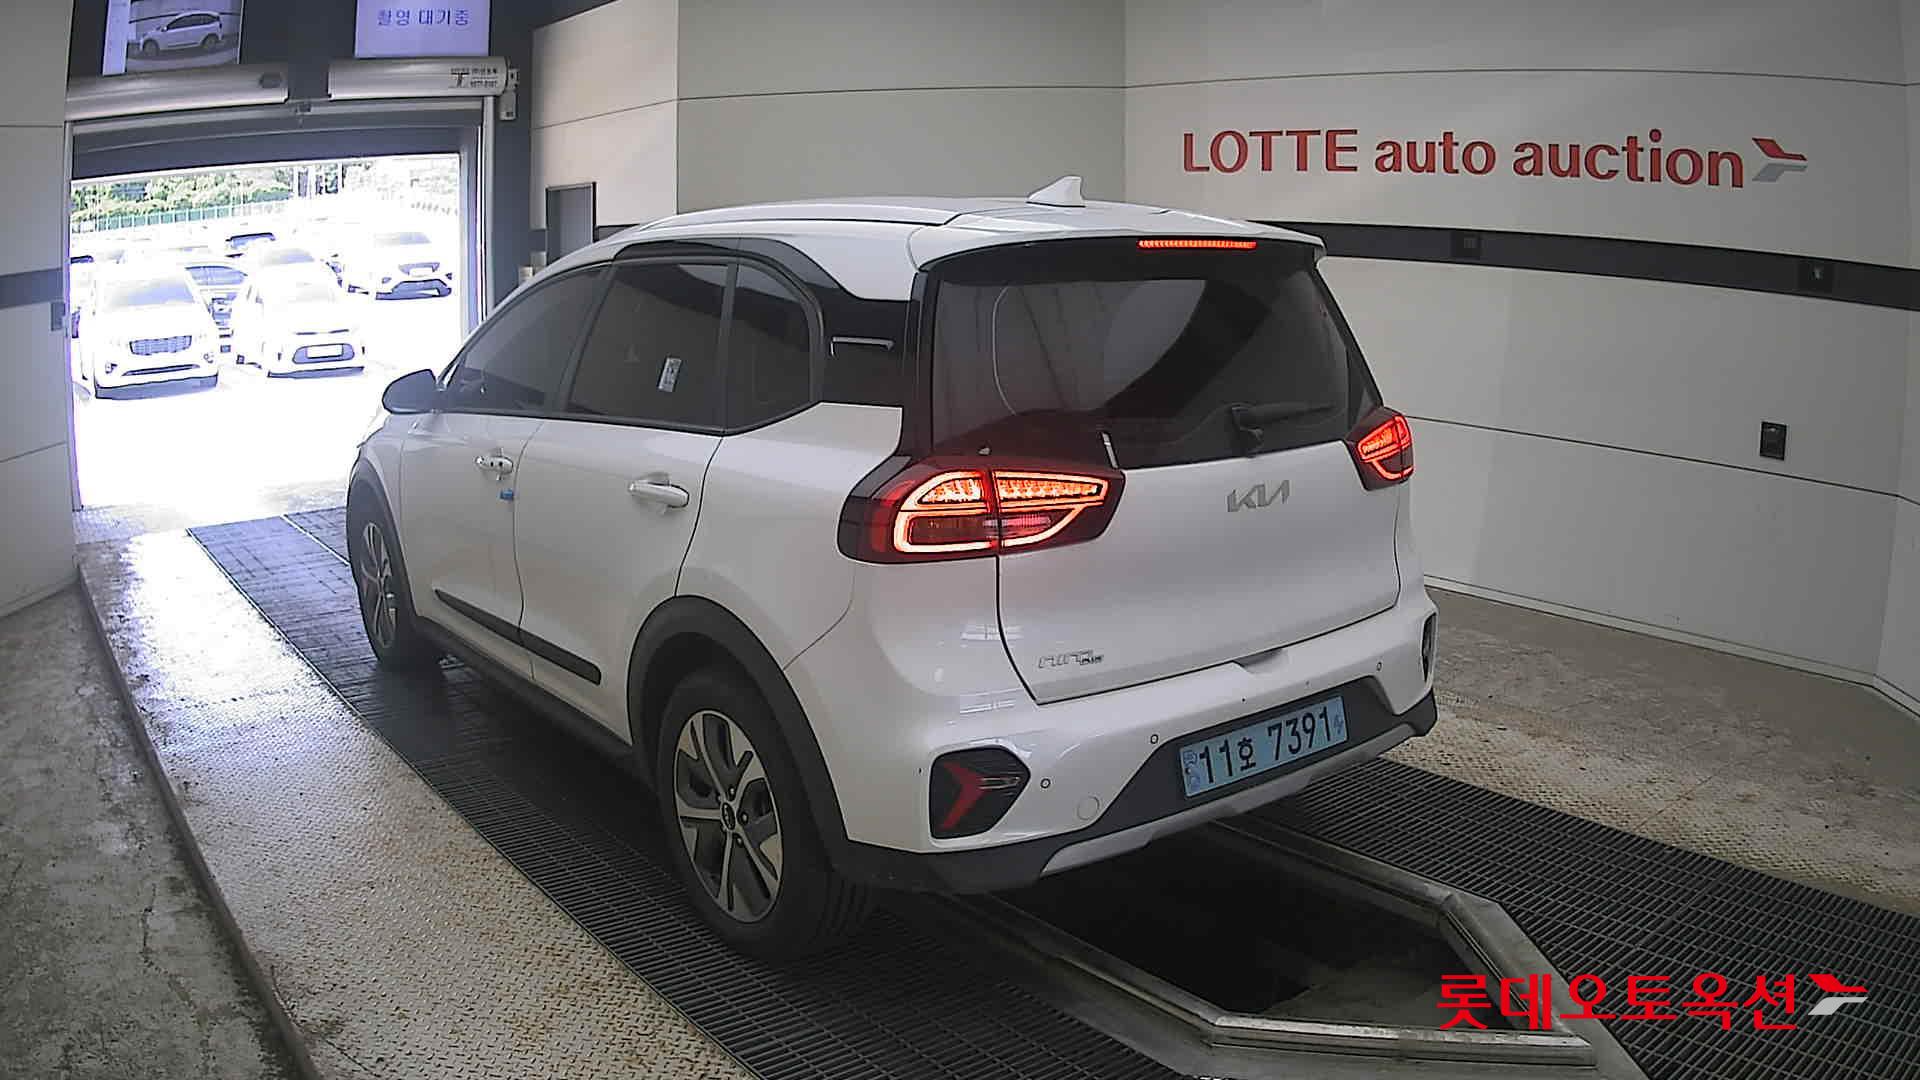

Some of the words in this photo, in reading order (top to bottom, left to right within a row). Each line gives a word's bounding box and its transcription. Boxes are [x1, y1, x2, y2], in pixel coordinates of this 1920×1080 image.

[418, 8, 469, 26] 대기중
[1183, 128, 1359, 173] LOTTE
[1375, 131, 1497, 176] auto
[1513, 129, 1744, 188] auction
[1226, 479, 1290, 513] KIA
[1199, 736, 1256, 784] 11호
[1267, 706, 1332, 761] 7391
